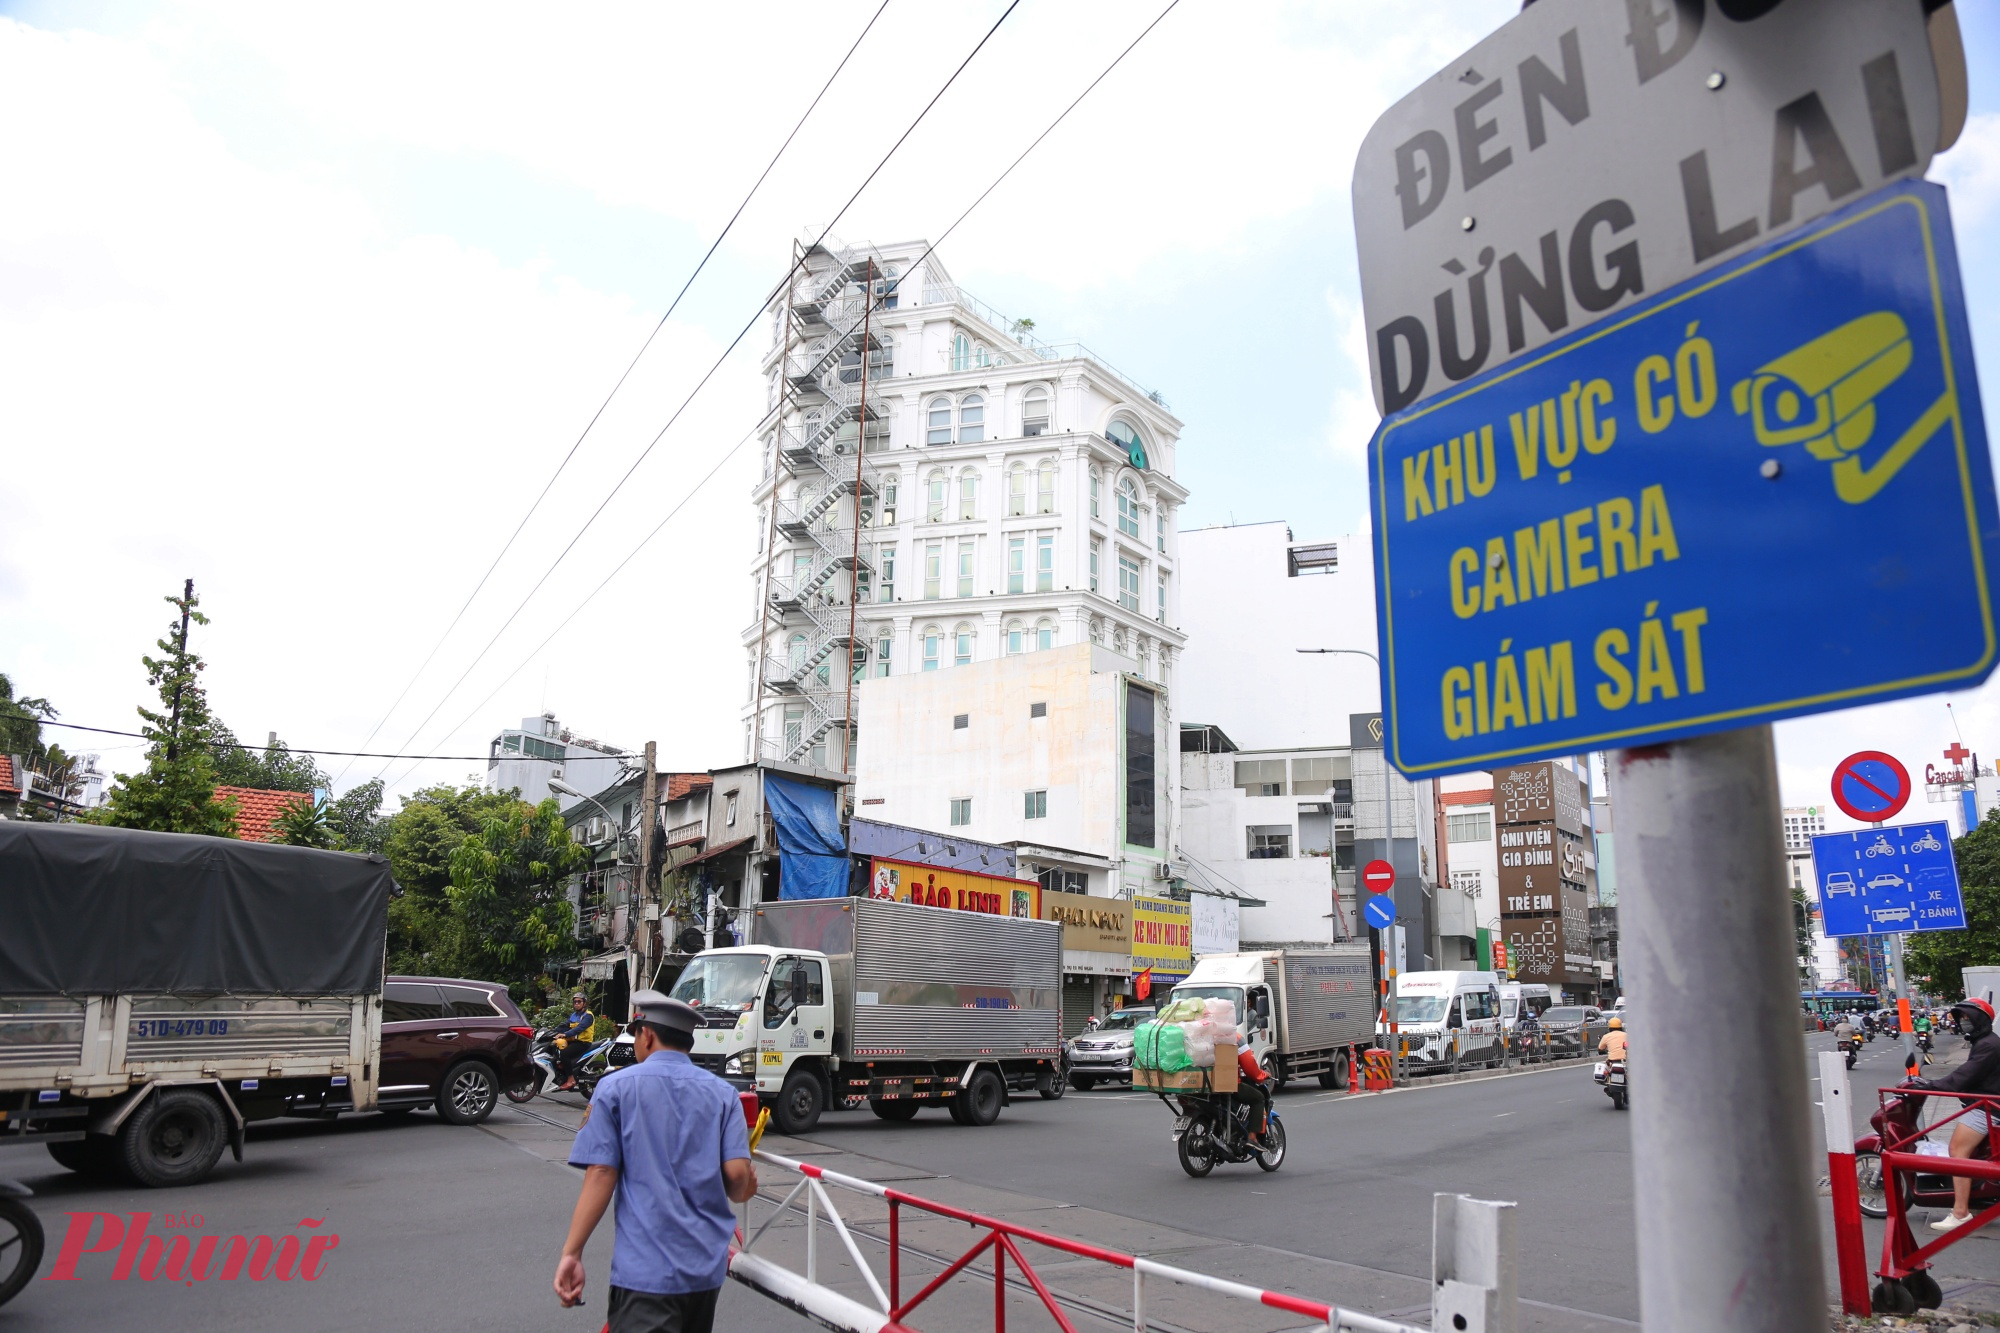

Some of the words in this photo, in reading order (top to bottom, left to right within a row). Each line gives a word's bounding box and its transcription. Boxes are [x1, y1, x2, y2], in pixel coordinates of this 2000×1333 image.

[1394, 27, 1591, 231] ĐÈN
[1376, 198, 1645, 418] DỪNG
[1402, 425, 1496, 522] KHU
[1509, 377, 1617, 485] VỰC
[1634, 320, 1719, 434] CÓ
[1448, 483, 1681, 620] CAMERA
[1441, 637, 1578, 742] GIÁM
[1594, 600, 1709, 711] SÁT
[1501, 829, 1524, 847] ẢNH
[1526, 828, 1551, 848] VIỆN
[1502, 852, 1521, 867] GIA
[1524, 848, 1552, 866] ĐÌNH
[911, 873, 951, 909] BẢO
[958, 889, 1001, 914] LINH
[1525, 874, 1533, 888] &
[1508, 892, 1530, 911] TRẺ
[1534, 895, 1552, 910] EM
[1928, 891, 1942, 900] XE
[1920, 910, 1926, 918] 2
[1928, 905, 1957, 918] BÁNH
[1134, 920, 1144, 943] XE
[1147, 916, 1162, 944] MÁY
[1165, 923, 1178, 951] MỤI
[138, 1019, 204, 1036] 51D-479
[208, 1019, 228, 1035] 09
